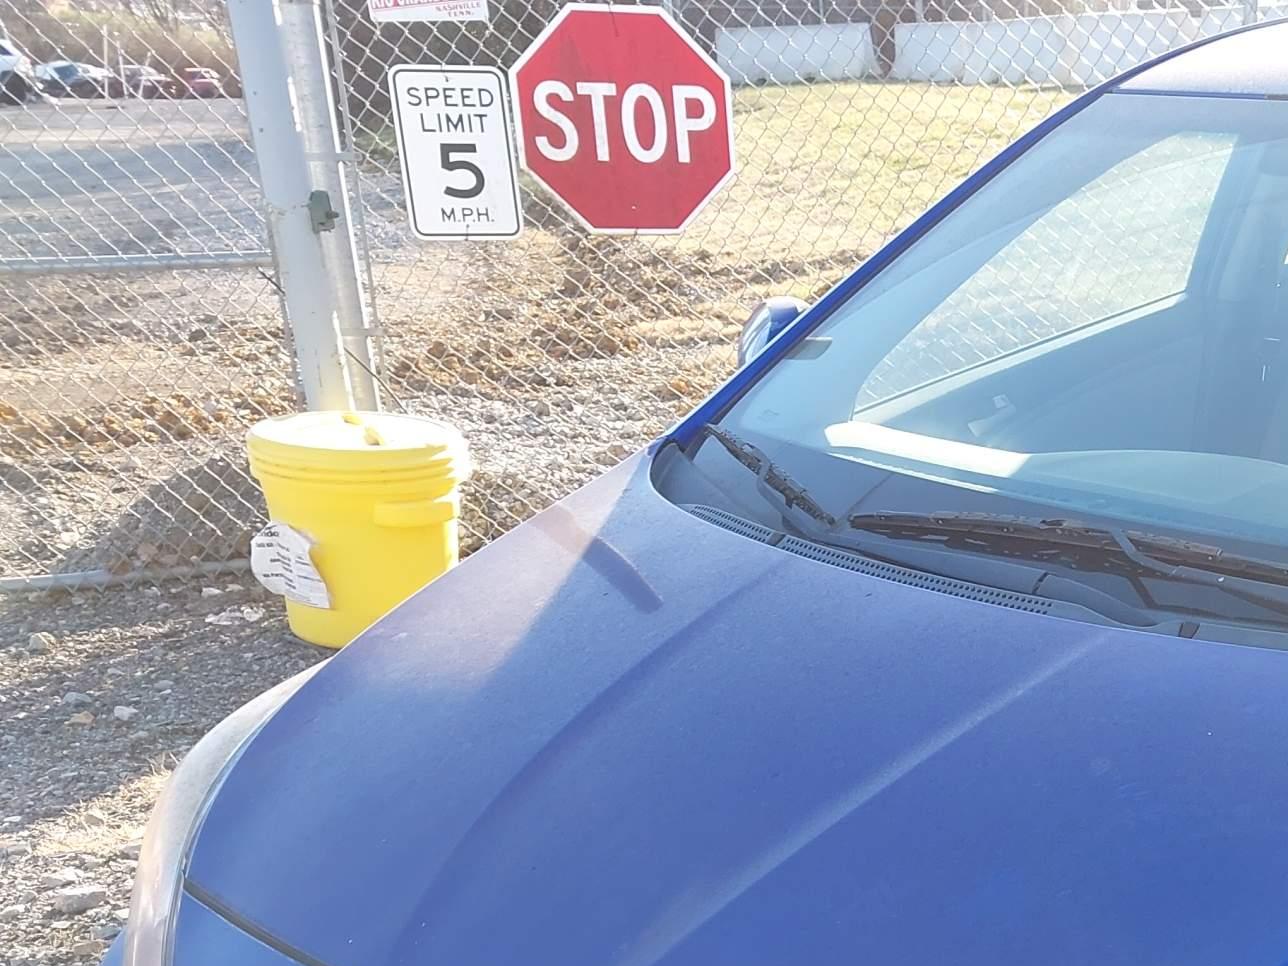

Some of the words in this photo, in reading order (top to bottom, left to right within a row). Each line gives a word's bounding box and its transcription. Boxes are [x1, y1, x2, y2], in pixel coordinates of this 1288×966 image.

[407, 86, 494, 108] SPEED
[421, 112, 488, 134] LIMIT
[532, 80, 717, 164] STOP
[440, 142, 486, 200] 5
[441, 206, 495, 223] M.P.H.
